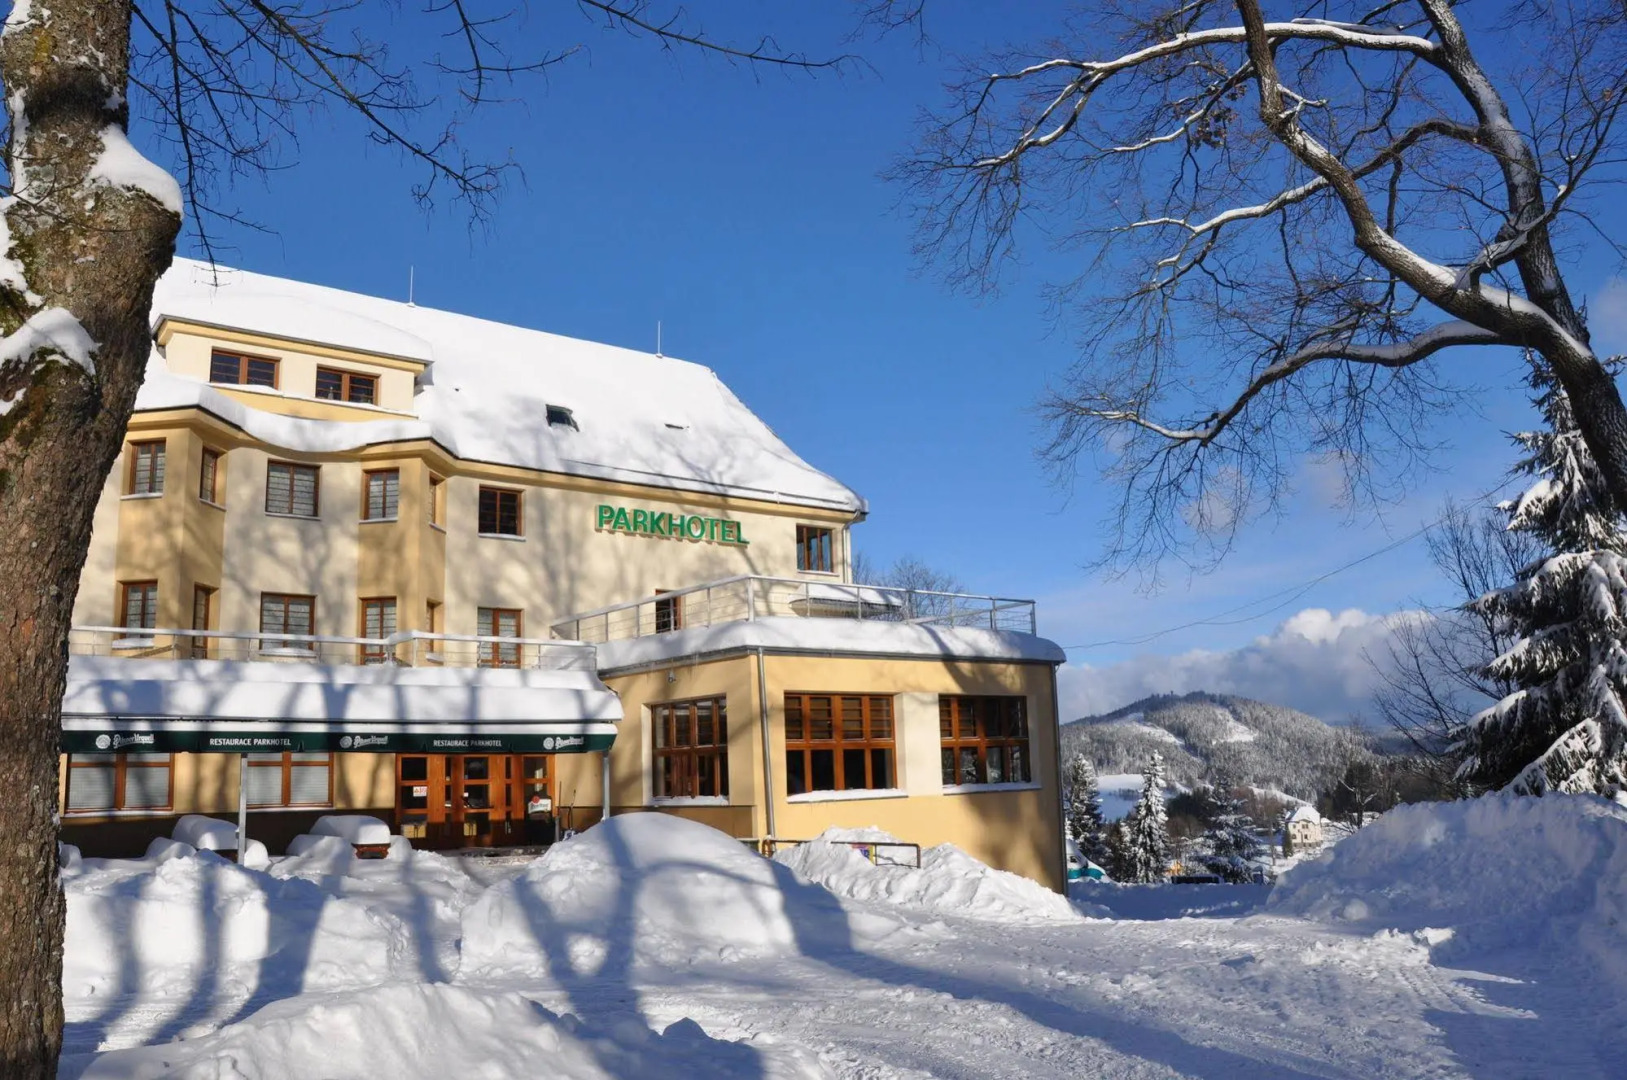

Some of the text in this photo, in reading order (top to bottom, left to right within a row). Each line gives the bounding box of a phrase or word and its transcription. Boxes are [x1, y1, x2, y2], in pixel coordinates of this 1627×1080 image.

[596, 504, 750, 545] PARKHOTEL
[209, 738, 292, 746] RESTAURACE PARKHOTEL
[433, 739, 502, 747] RESTAURACE PARKHOTEL
